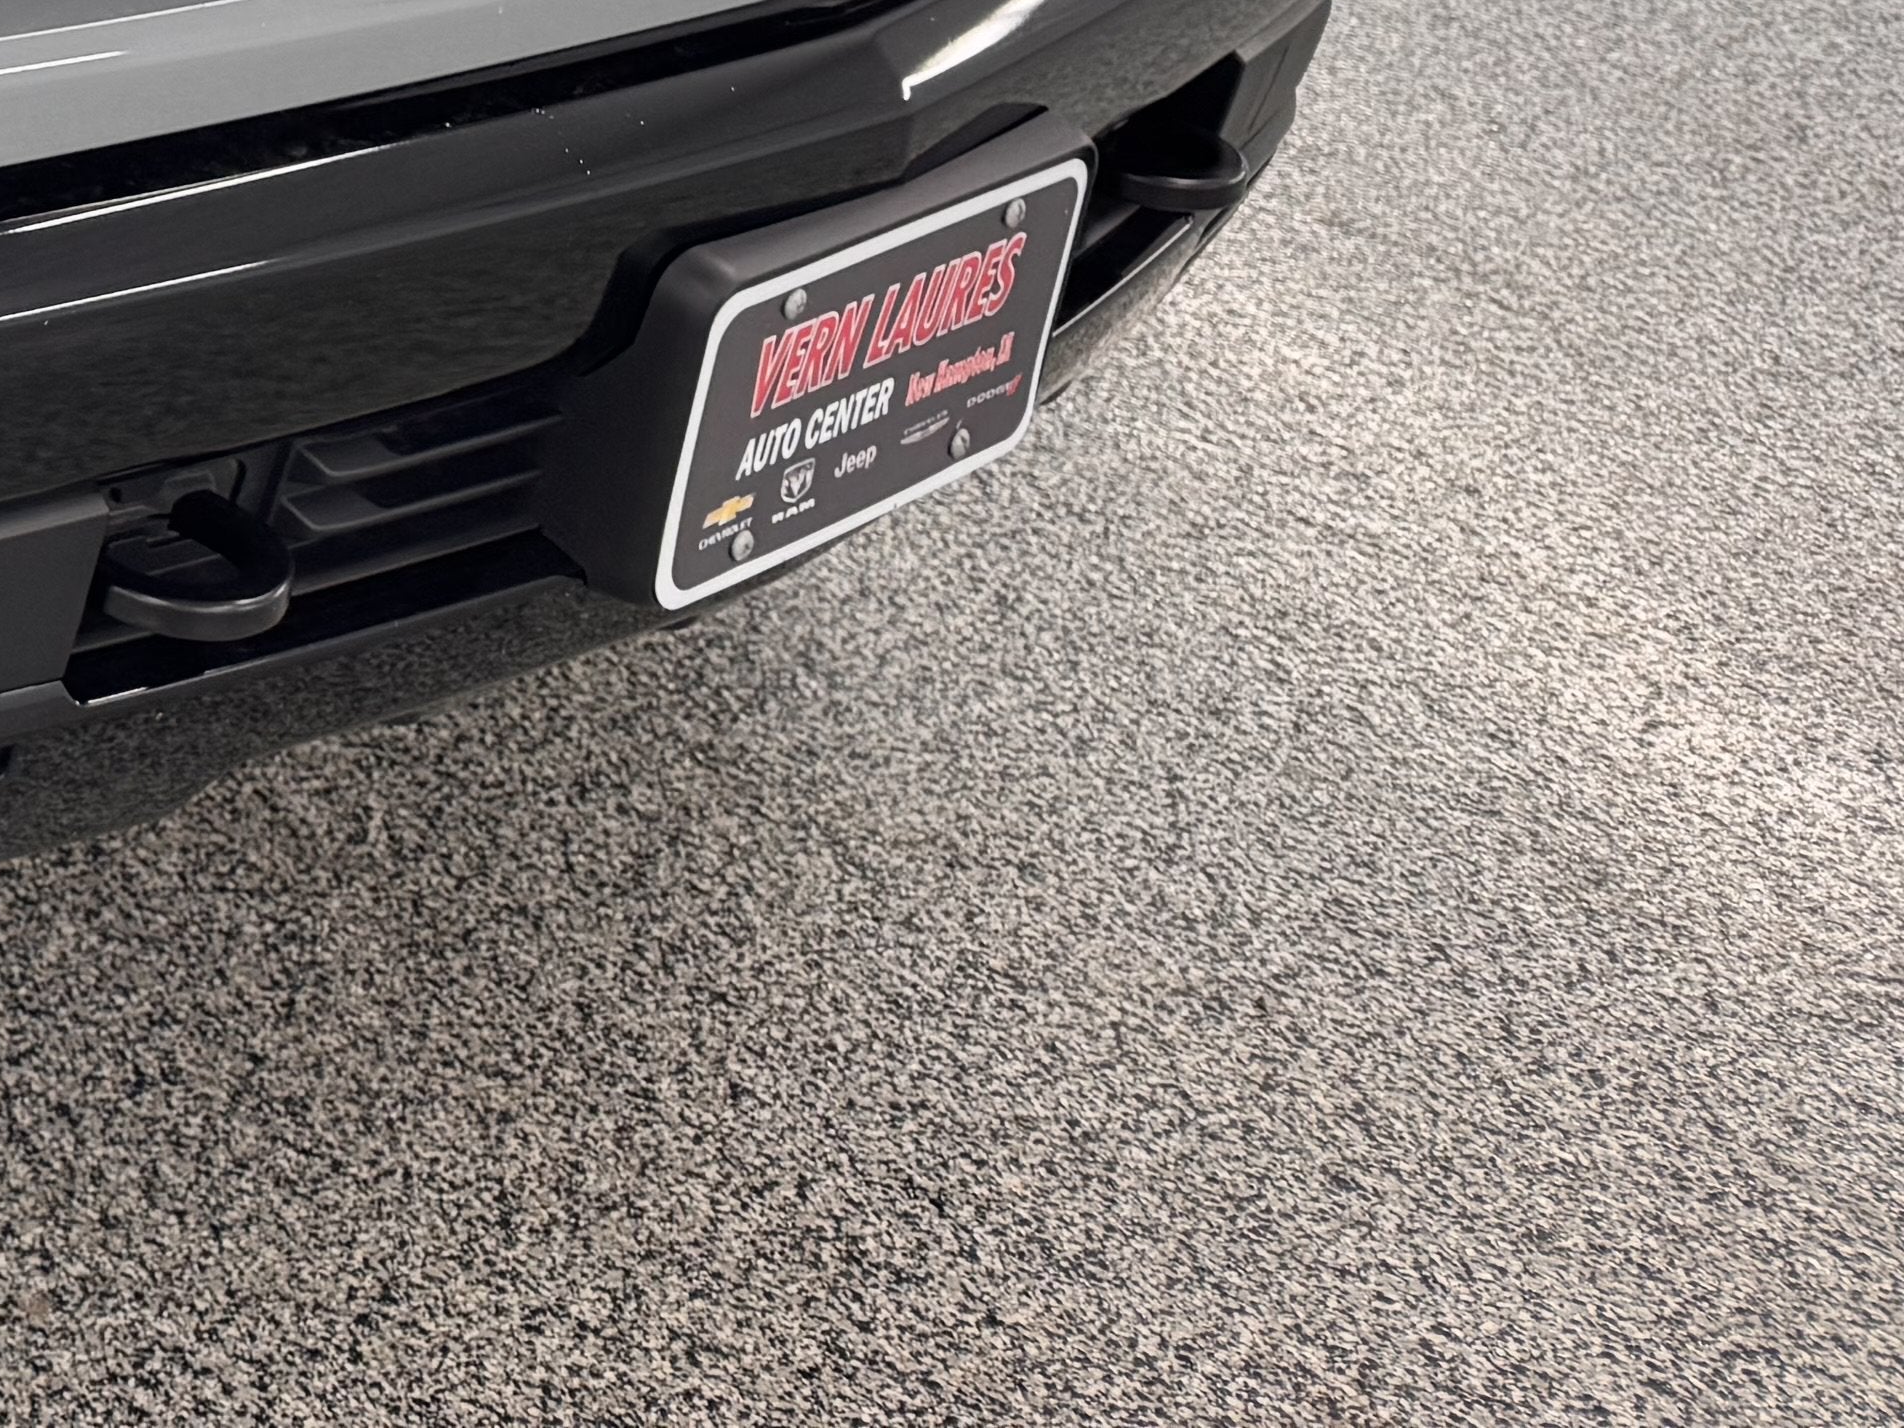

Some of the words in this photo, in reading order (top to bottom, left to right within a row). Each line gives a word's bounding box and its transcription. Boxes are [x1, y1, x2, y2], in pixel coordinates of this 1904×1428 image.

[749, 294, 875, 419] VERN
[863, 231, 1028, 370] LAURES
[905, 371, 937, 407] New
[735, 416, 801, 481] AUTO
[805, 377, 896, 450] CENTER
[833, 445, 877, 479] Jeep
[771, 497, 817, 525] RAM
